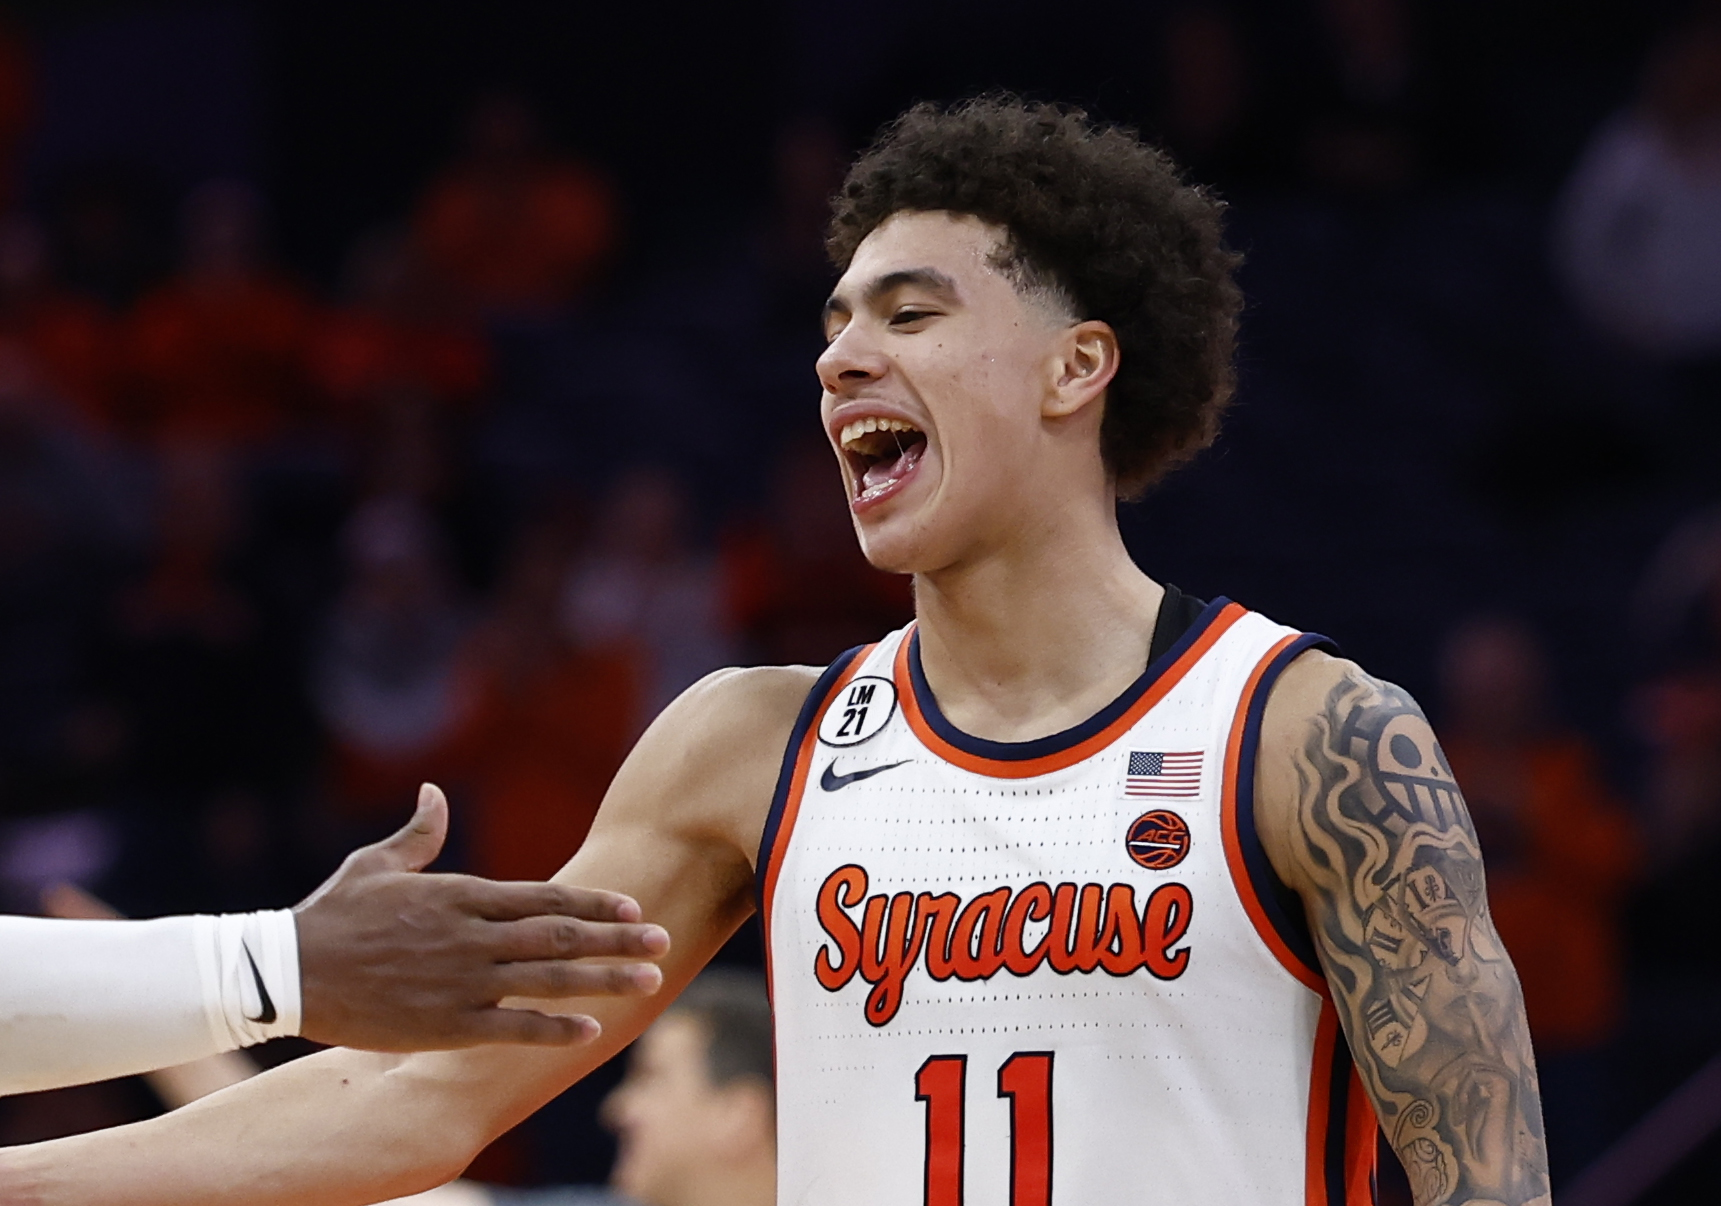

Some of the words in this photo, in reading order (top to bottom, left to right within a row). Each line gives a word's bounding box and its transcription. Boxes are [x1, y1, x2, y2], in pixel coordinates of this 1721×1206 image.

[847, 684, 877, 707] LM
[836, 706, 868, 738] 21
[1137, 829, 1186, 844] ACC
[814, 863, 1194, 1027] Syracuse
